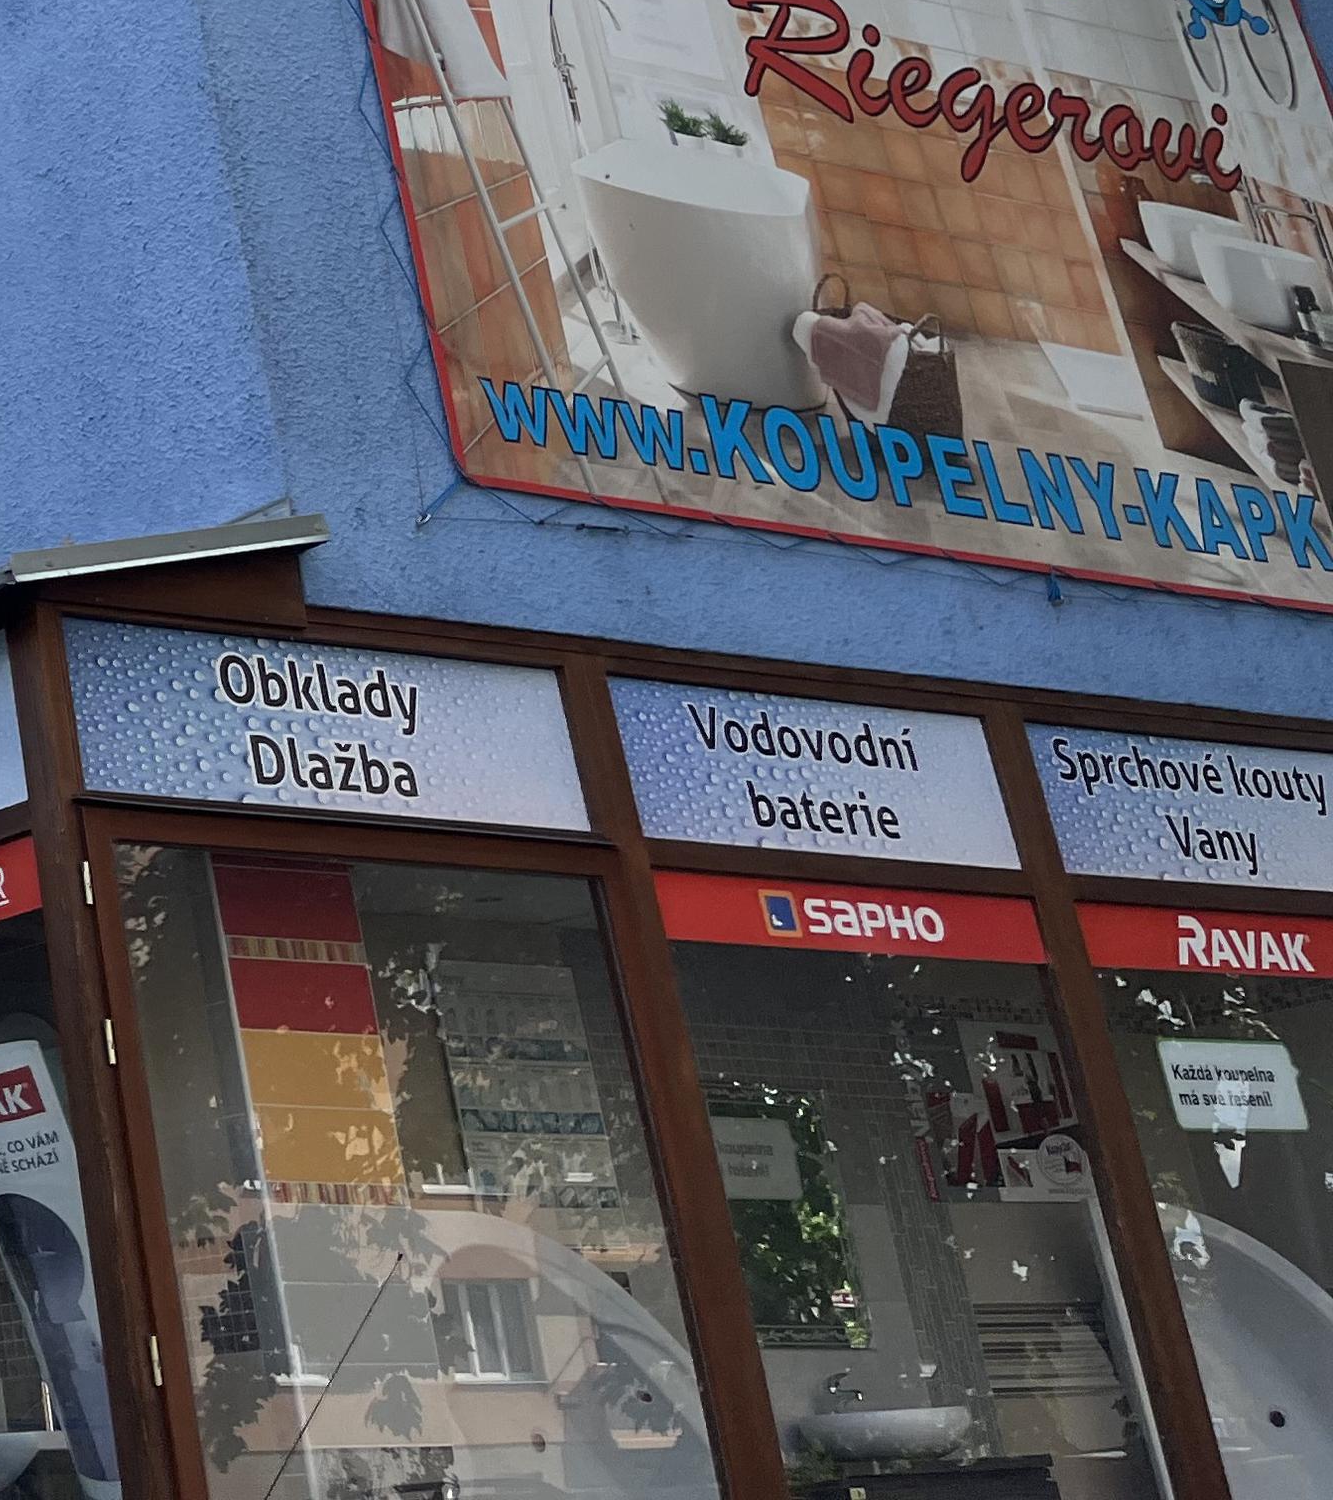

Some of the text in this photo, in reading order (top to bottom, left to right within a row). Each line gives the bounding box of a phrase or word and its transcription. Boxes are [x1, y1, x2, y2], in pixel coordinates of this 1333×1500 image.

[219, 652, 419, 735] Obklady
[249, 734, 419, 797] Dlažba
[687, 703, 919, 772] Vodovodní
[1052, 738, 1326, 815] Sprchové kouty
[747, 780, 901, 840] baterie
[1165, 814, 1259, 875] Vany
[1178, 916, 1314, 972] RAVAK
[1171, 1064, 1275, 1085] Každá koupelna
[1179, 1090, 1200, 1105] má
[7, 1140, 24, 1153] CO
[26, 1130, 59, 1150] VÁM
[12, 1147, 60, 1173] SCHÁZÍ
